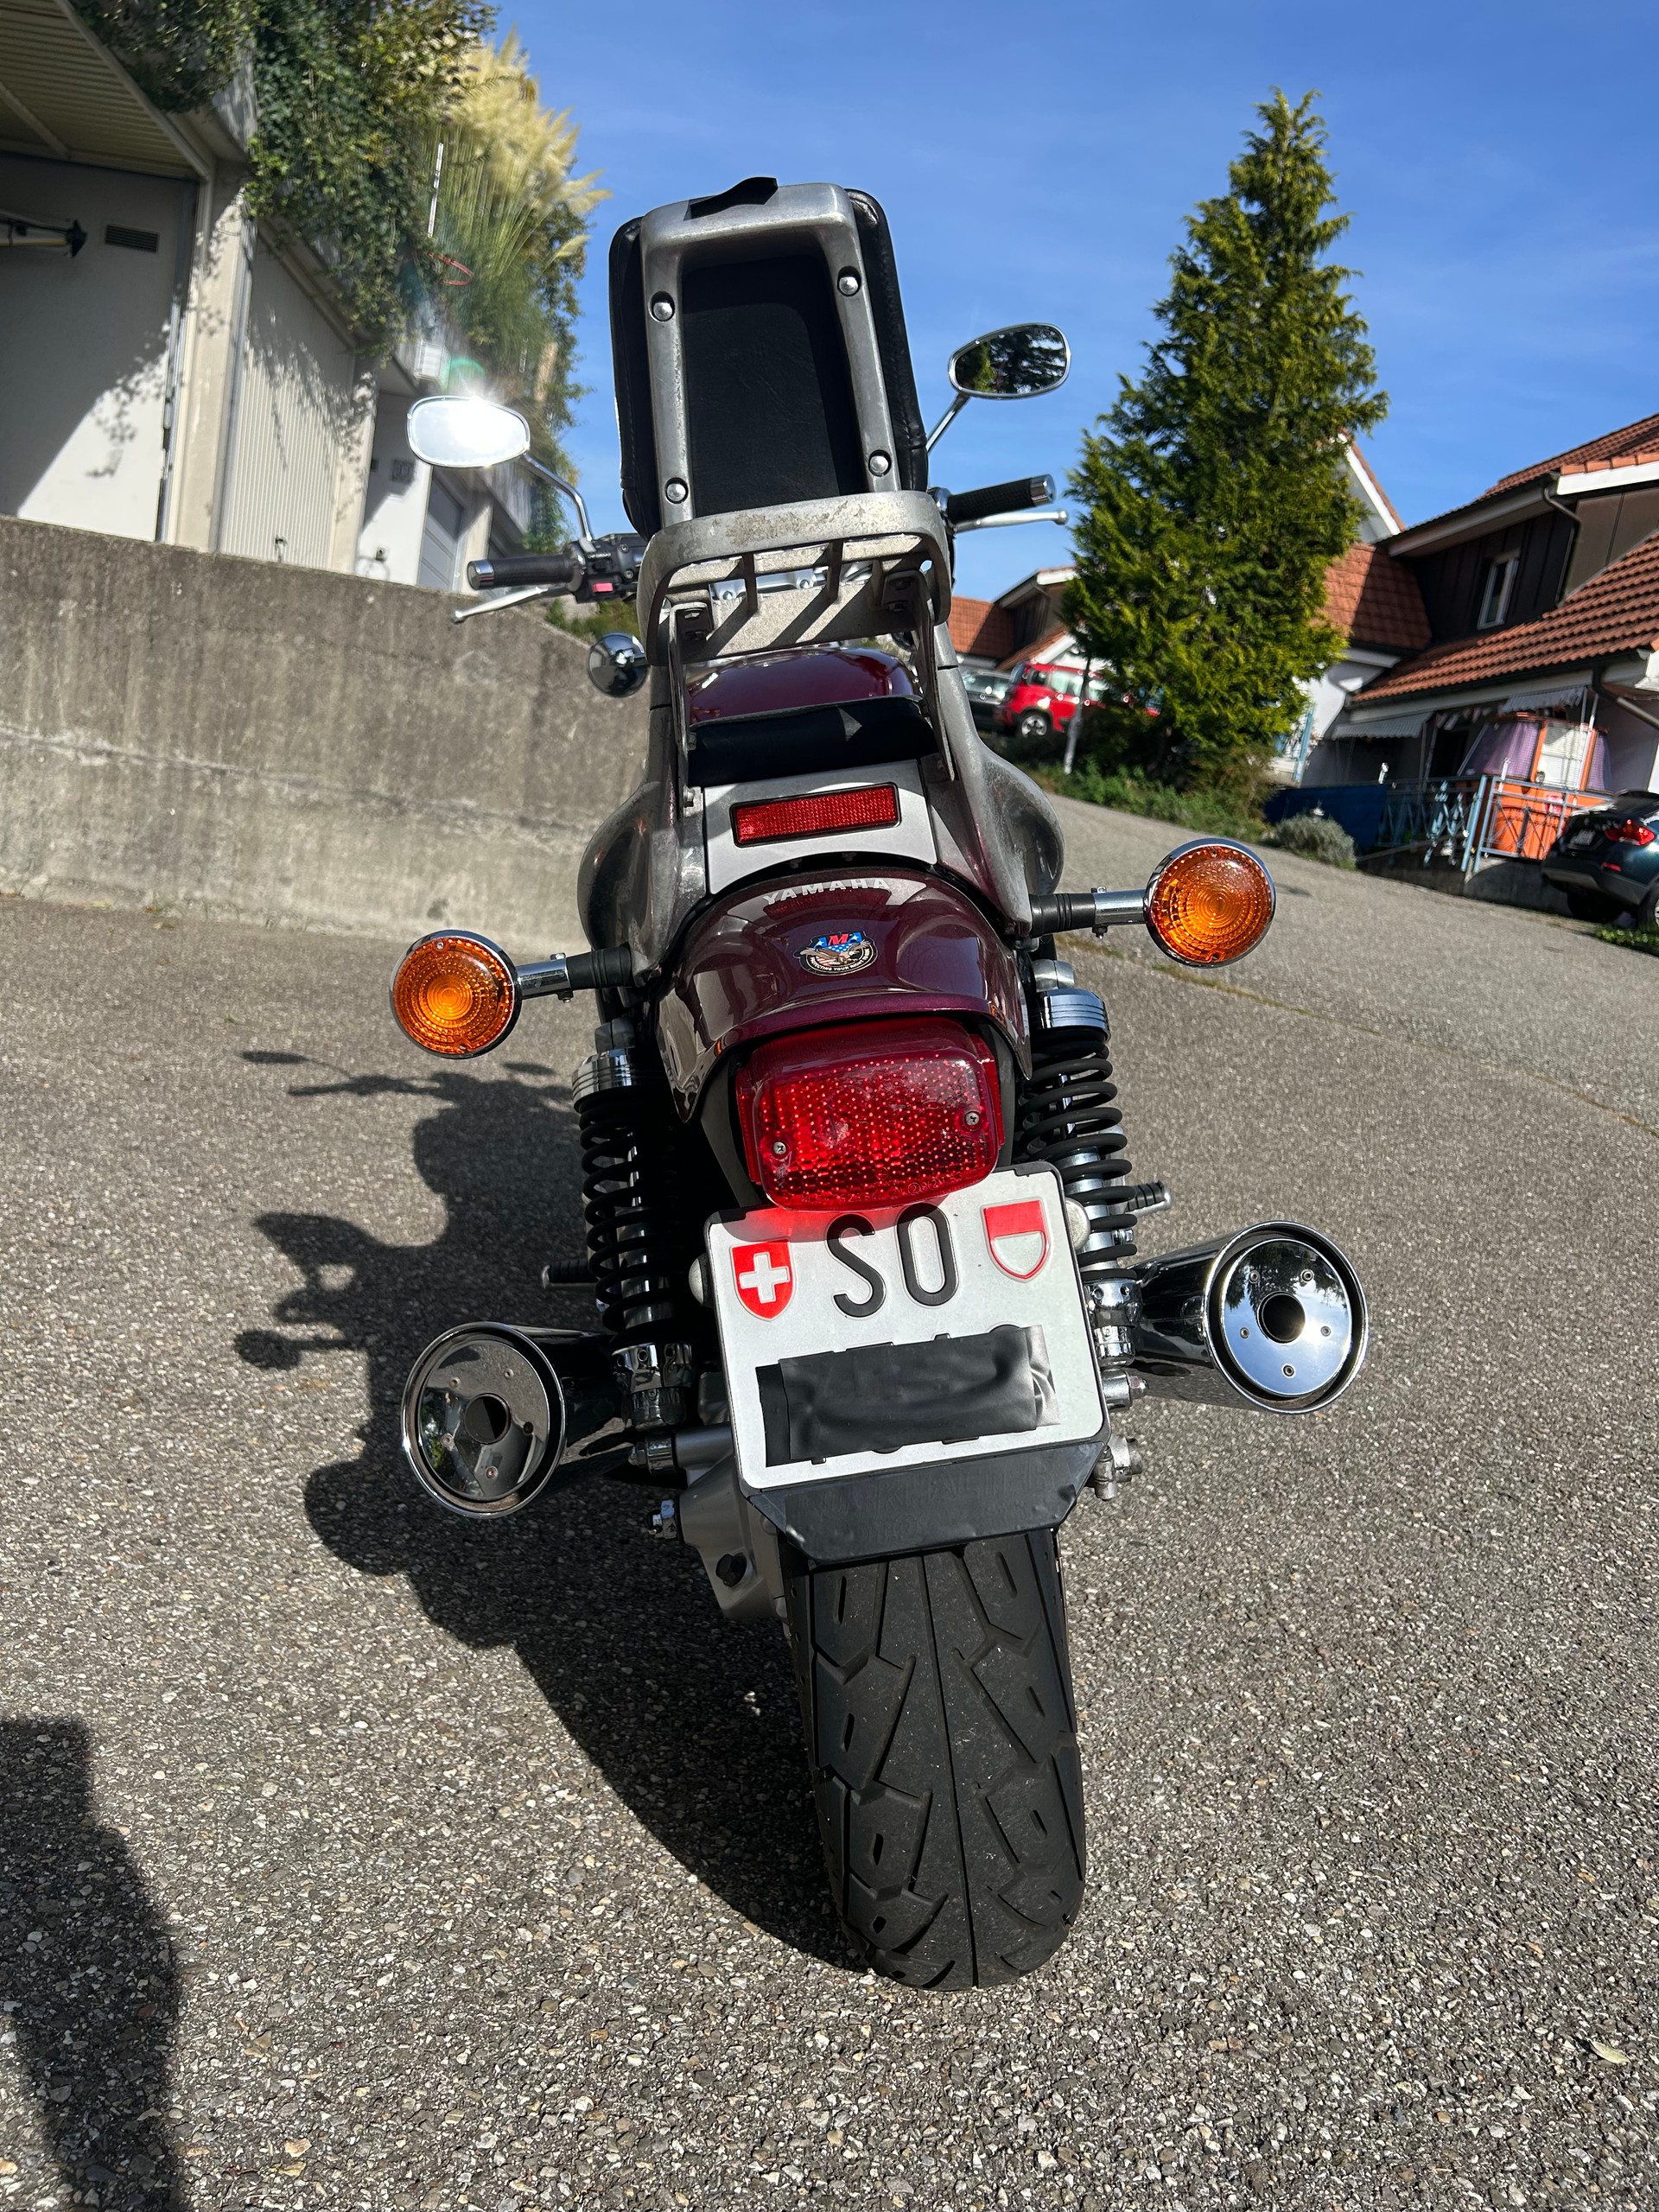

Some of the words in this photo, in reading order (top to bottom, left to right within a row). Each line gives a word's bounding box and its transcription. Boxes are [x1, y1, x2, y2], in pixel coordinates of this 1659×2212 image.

[763, 879, 890, 906] YAMAHA
[814, 931, 862, 949] AMA
[826, 1203, 959, 1317] SO
